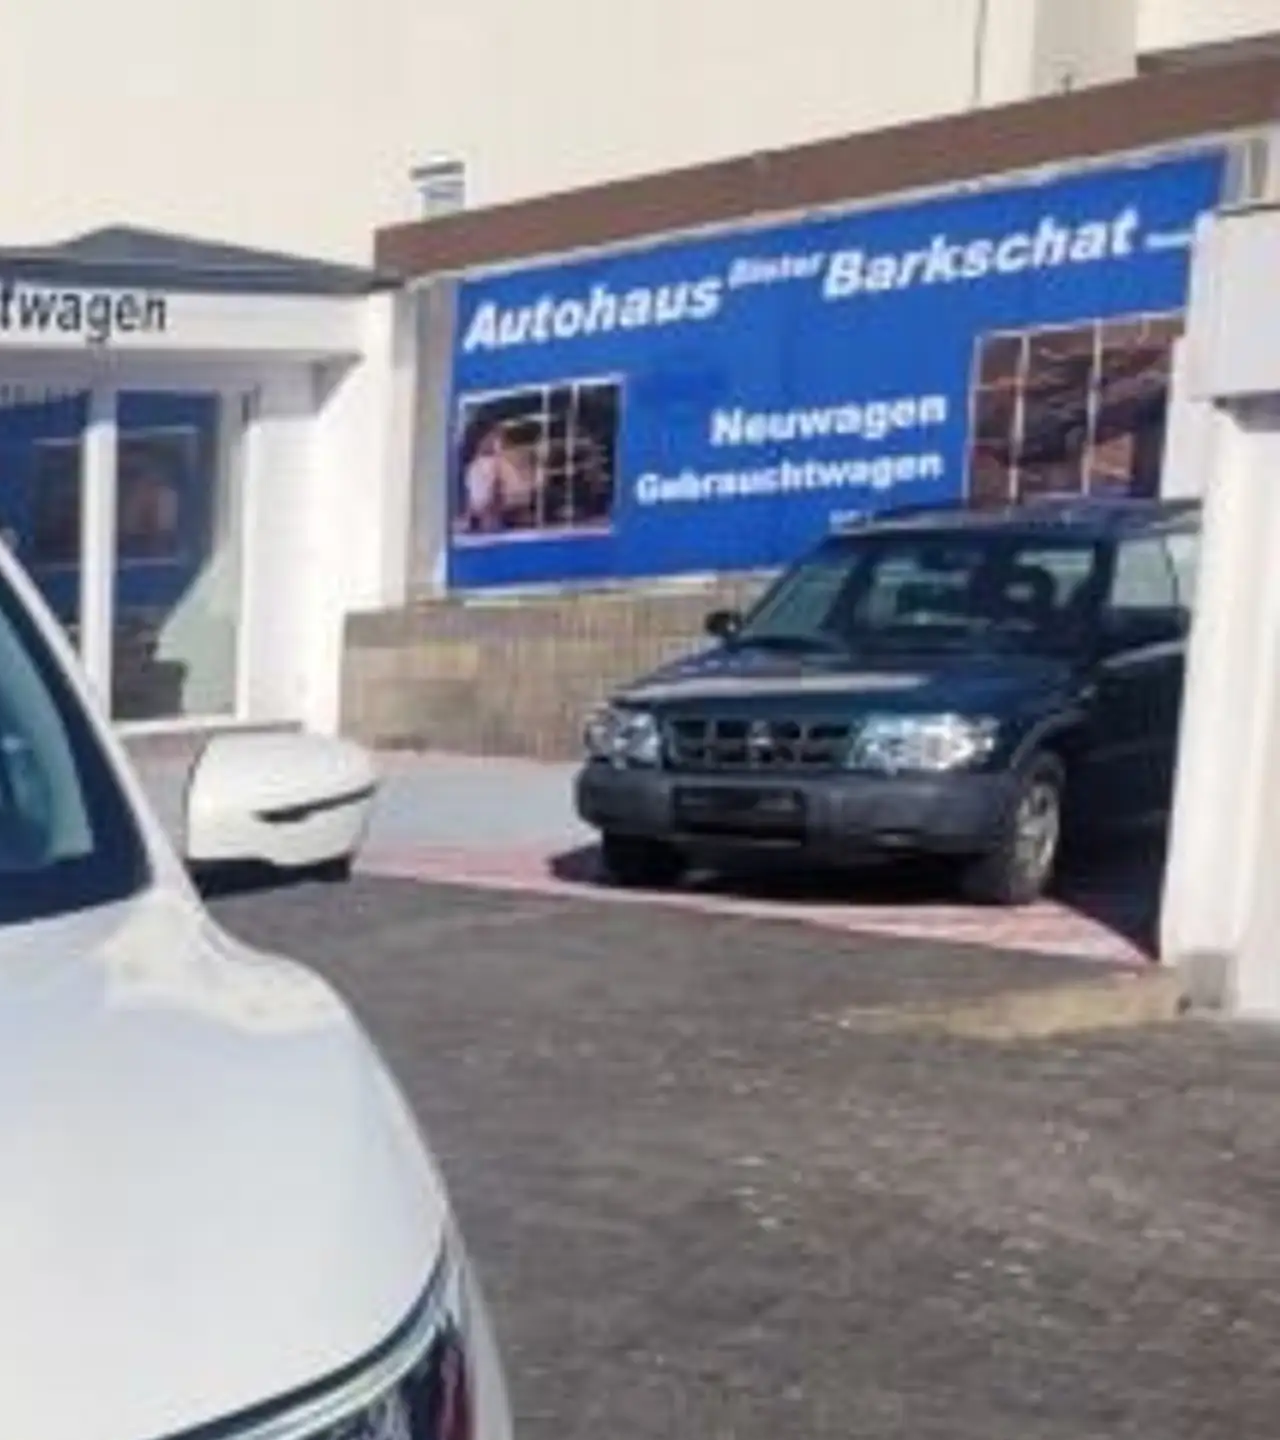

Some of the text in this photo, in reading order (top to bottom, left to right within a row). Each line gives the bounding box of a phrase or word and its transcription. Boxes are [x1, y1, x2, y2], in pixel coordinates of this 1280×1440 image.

[462, 274, 723, 354] Autohaus
[821, 204, 1139, 301] Barkschat
[708, 393, 947, 448] Neuwagen
[635, 453, 945, 505] Gebrauchtwagen
